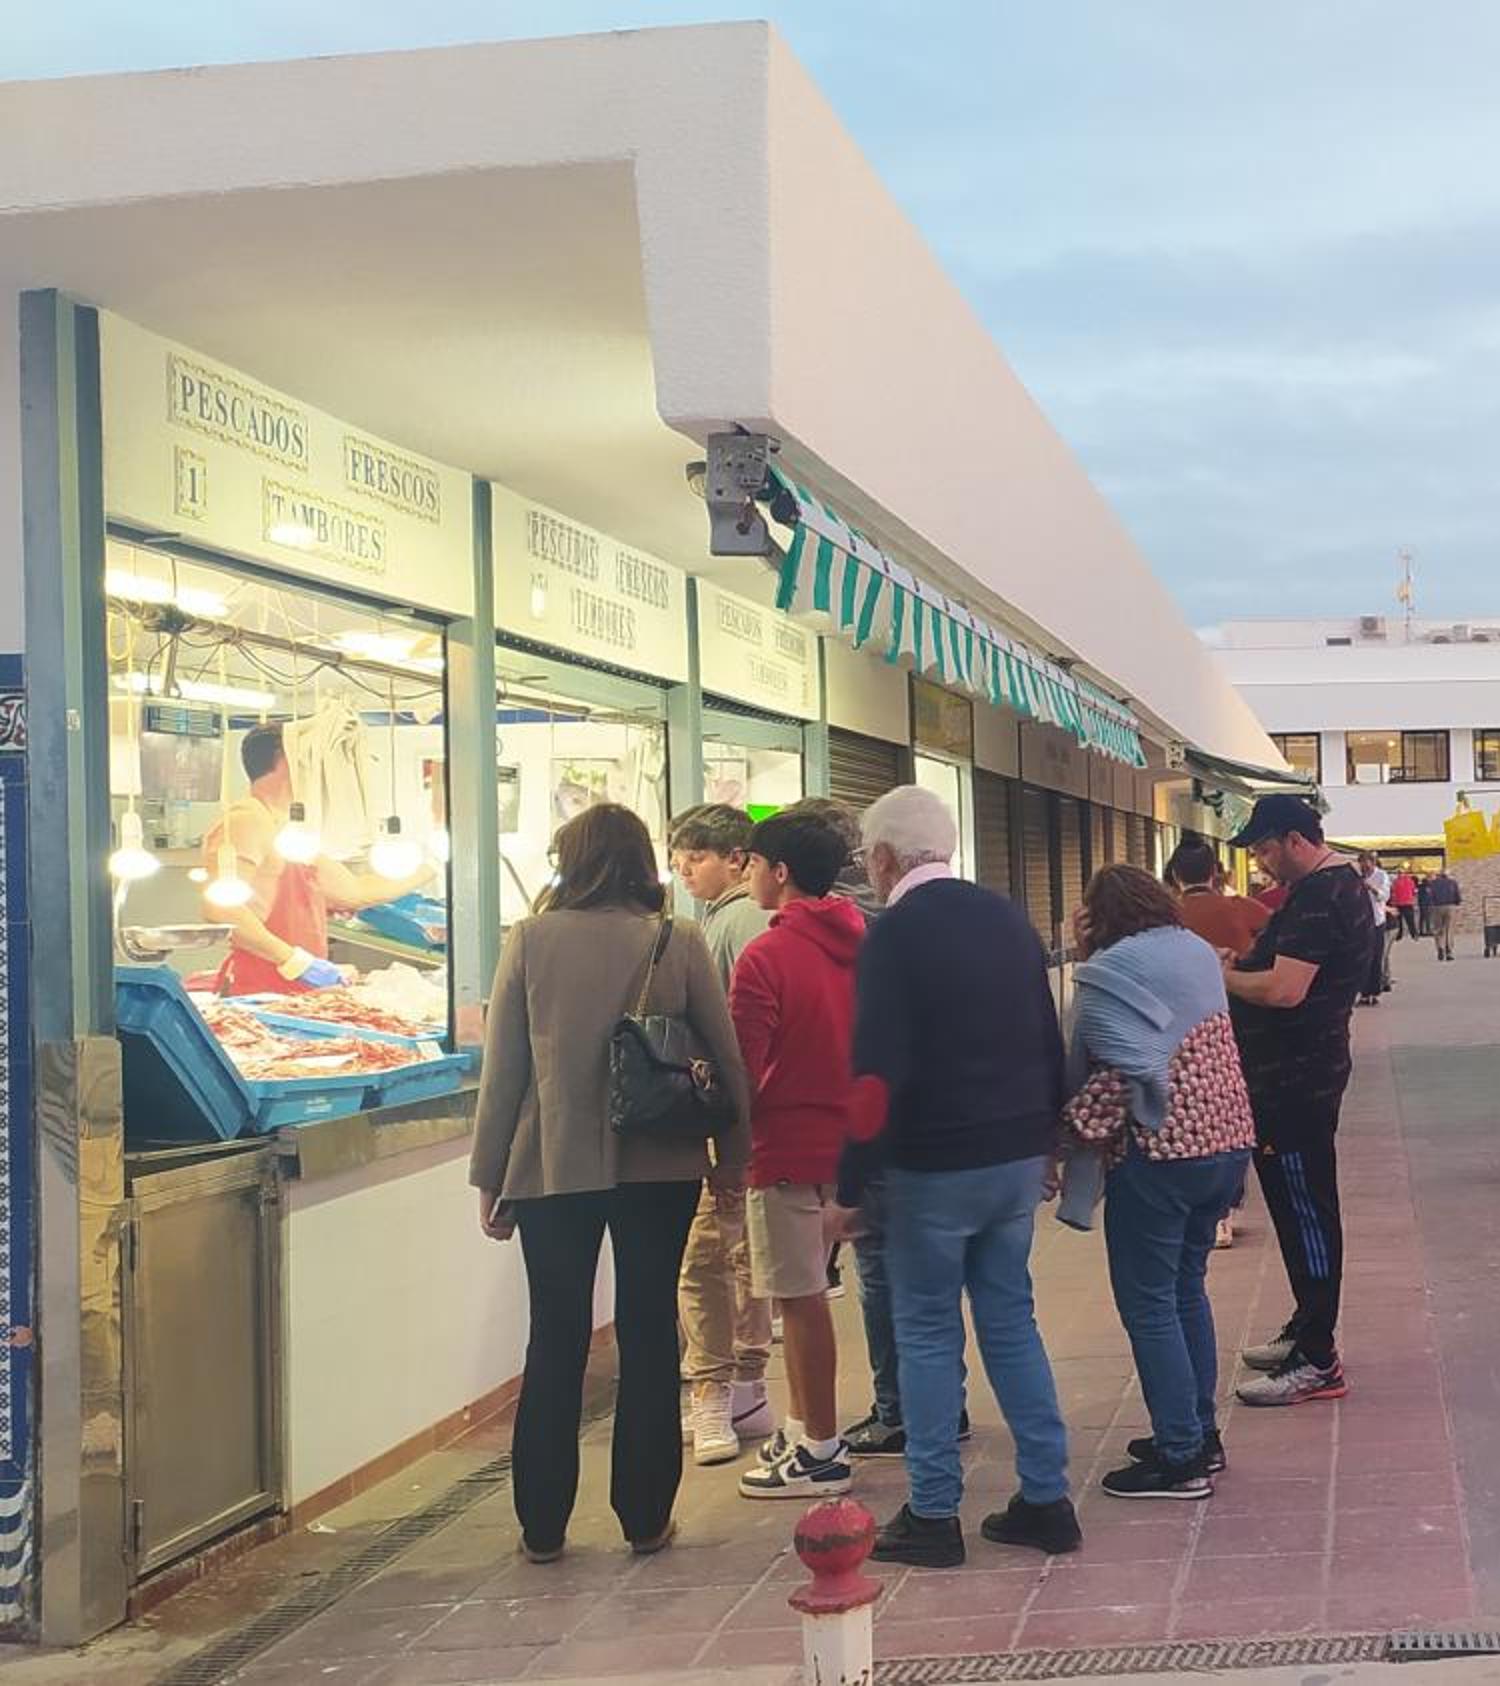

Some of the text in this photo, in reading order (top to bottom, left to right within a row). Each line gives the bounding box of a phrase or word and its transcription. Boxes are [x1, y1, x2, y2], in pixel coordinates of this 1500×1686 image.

[180, 374, 438, 513] PESCADOS FRESCOS
[188, 467, 382, 562] 1 TAMBORES
